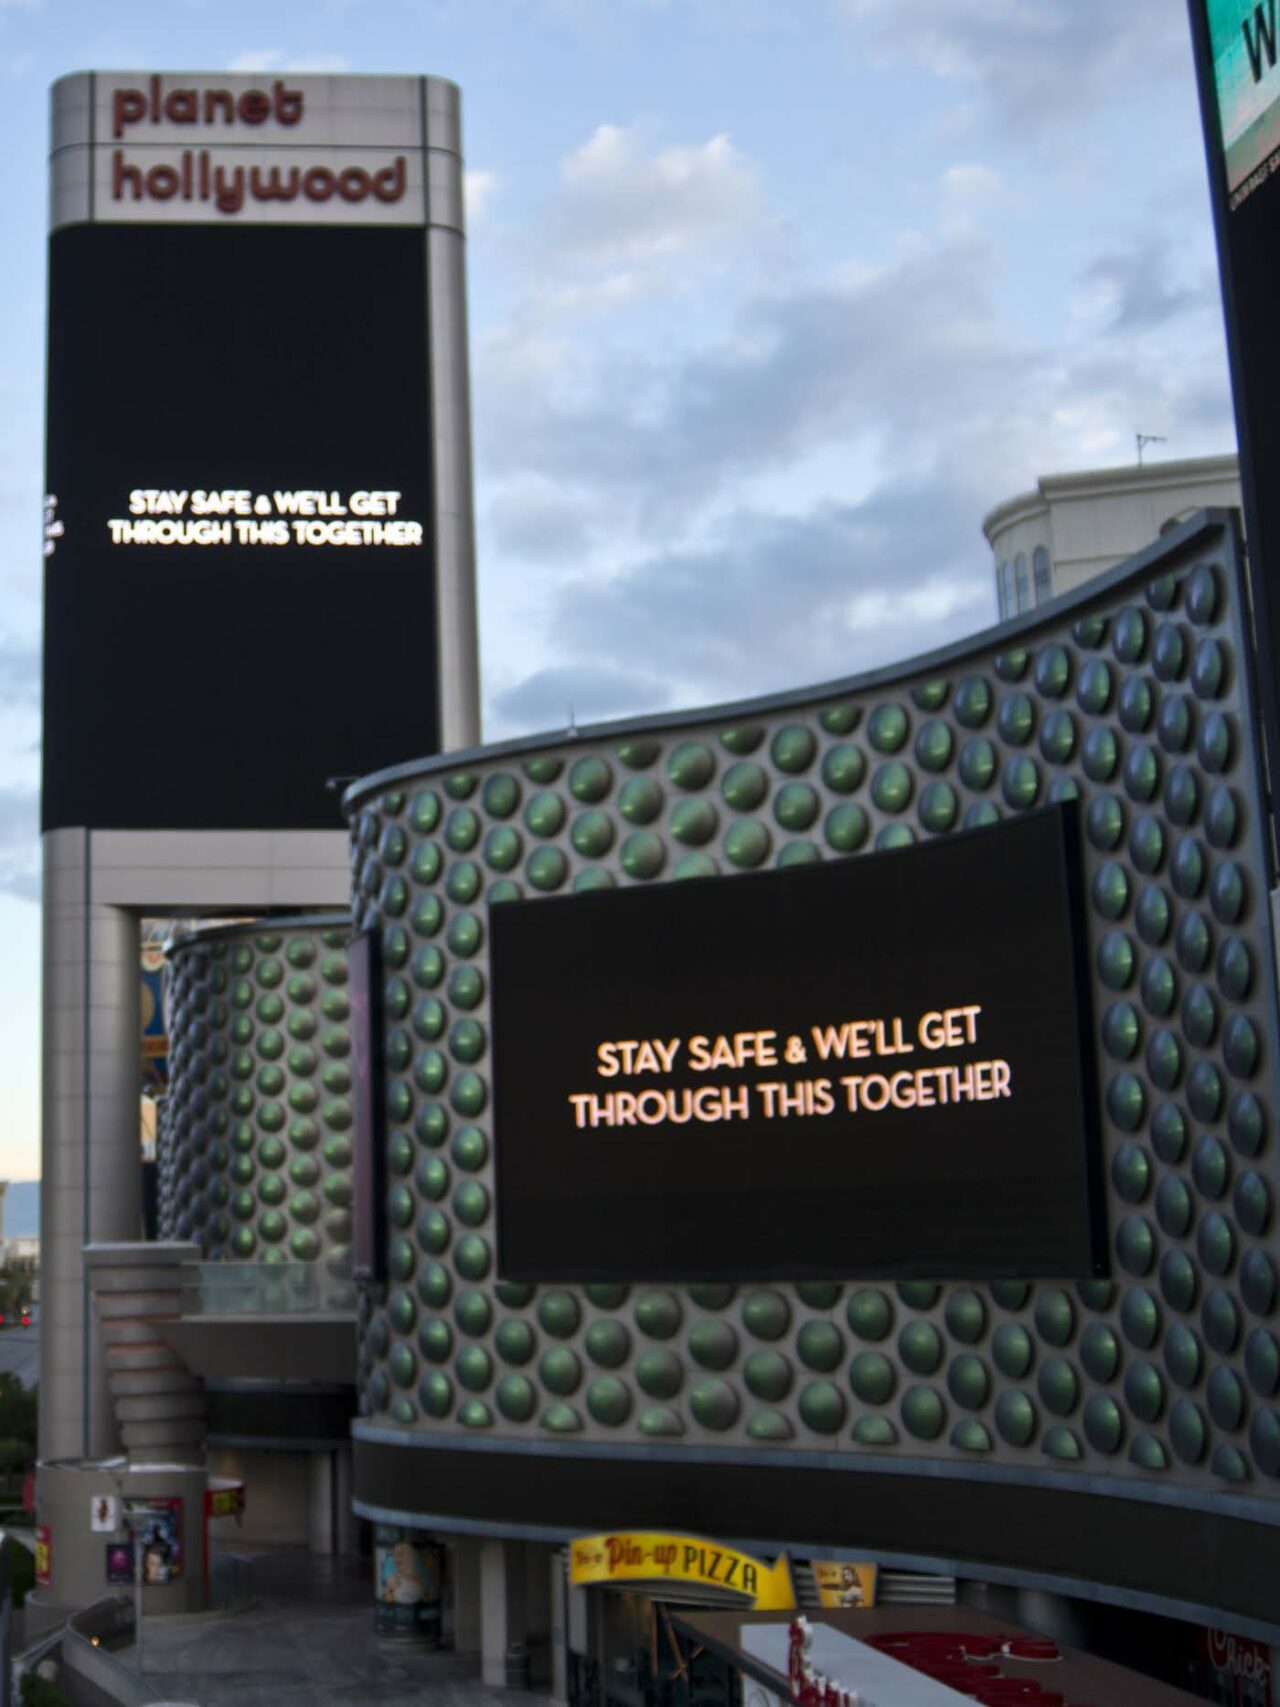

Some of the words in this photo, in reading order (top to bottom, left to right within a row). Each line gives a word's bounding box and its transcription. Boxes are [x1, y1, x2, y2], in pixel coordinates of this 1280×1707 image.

[112, 74, 304, 138] planet
[112, 149, 407, 215] hollywood
[107, 519, 233, 545] THROUGH
[233, 519, 291, 546] THIS
[292, 520, 423, 546] TOGETHER
[129, 489, 188, 515] STAY
[190, 489, 253, 515] SAFE
[253, 494, 272, 516] &
[273, 490, 348, 516] WE'LL
[348, 490, 402, 516] GET
[596, 1038, 680, 1077] STAY
[688, 1030, 778, 1071] SAFE
[784, 1035, 807, 1064] &
[811, 1017, 914, 1060] WE'LL
[918, 1005, 982, 1050] GET
[569, 1085, 749, 1128] THROUGH
[756, 1078, 834, 1118] THIS
[840, 1060, 1012, 1112] TOGETHER
[682, 1545, 757, 1595] PIZZA
